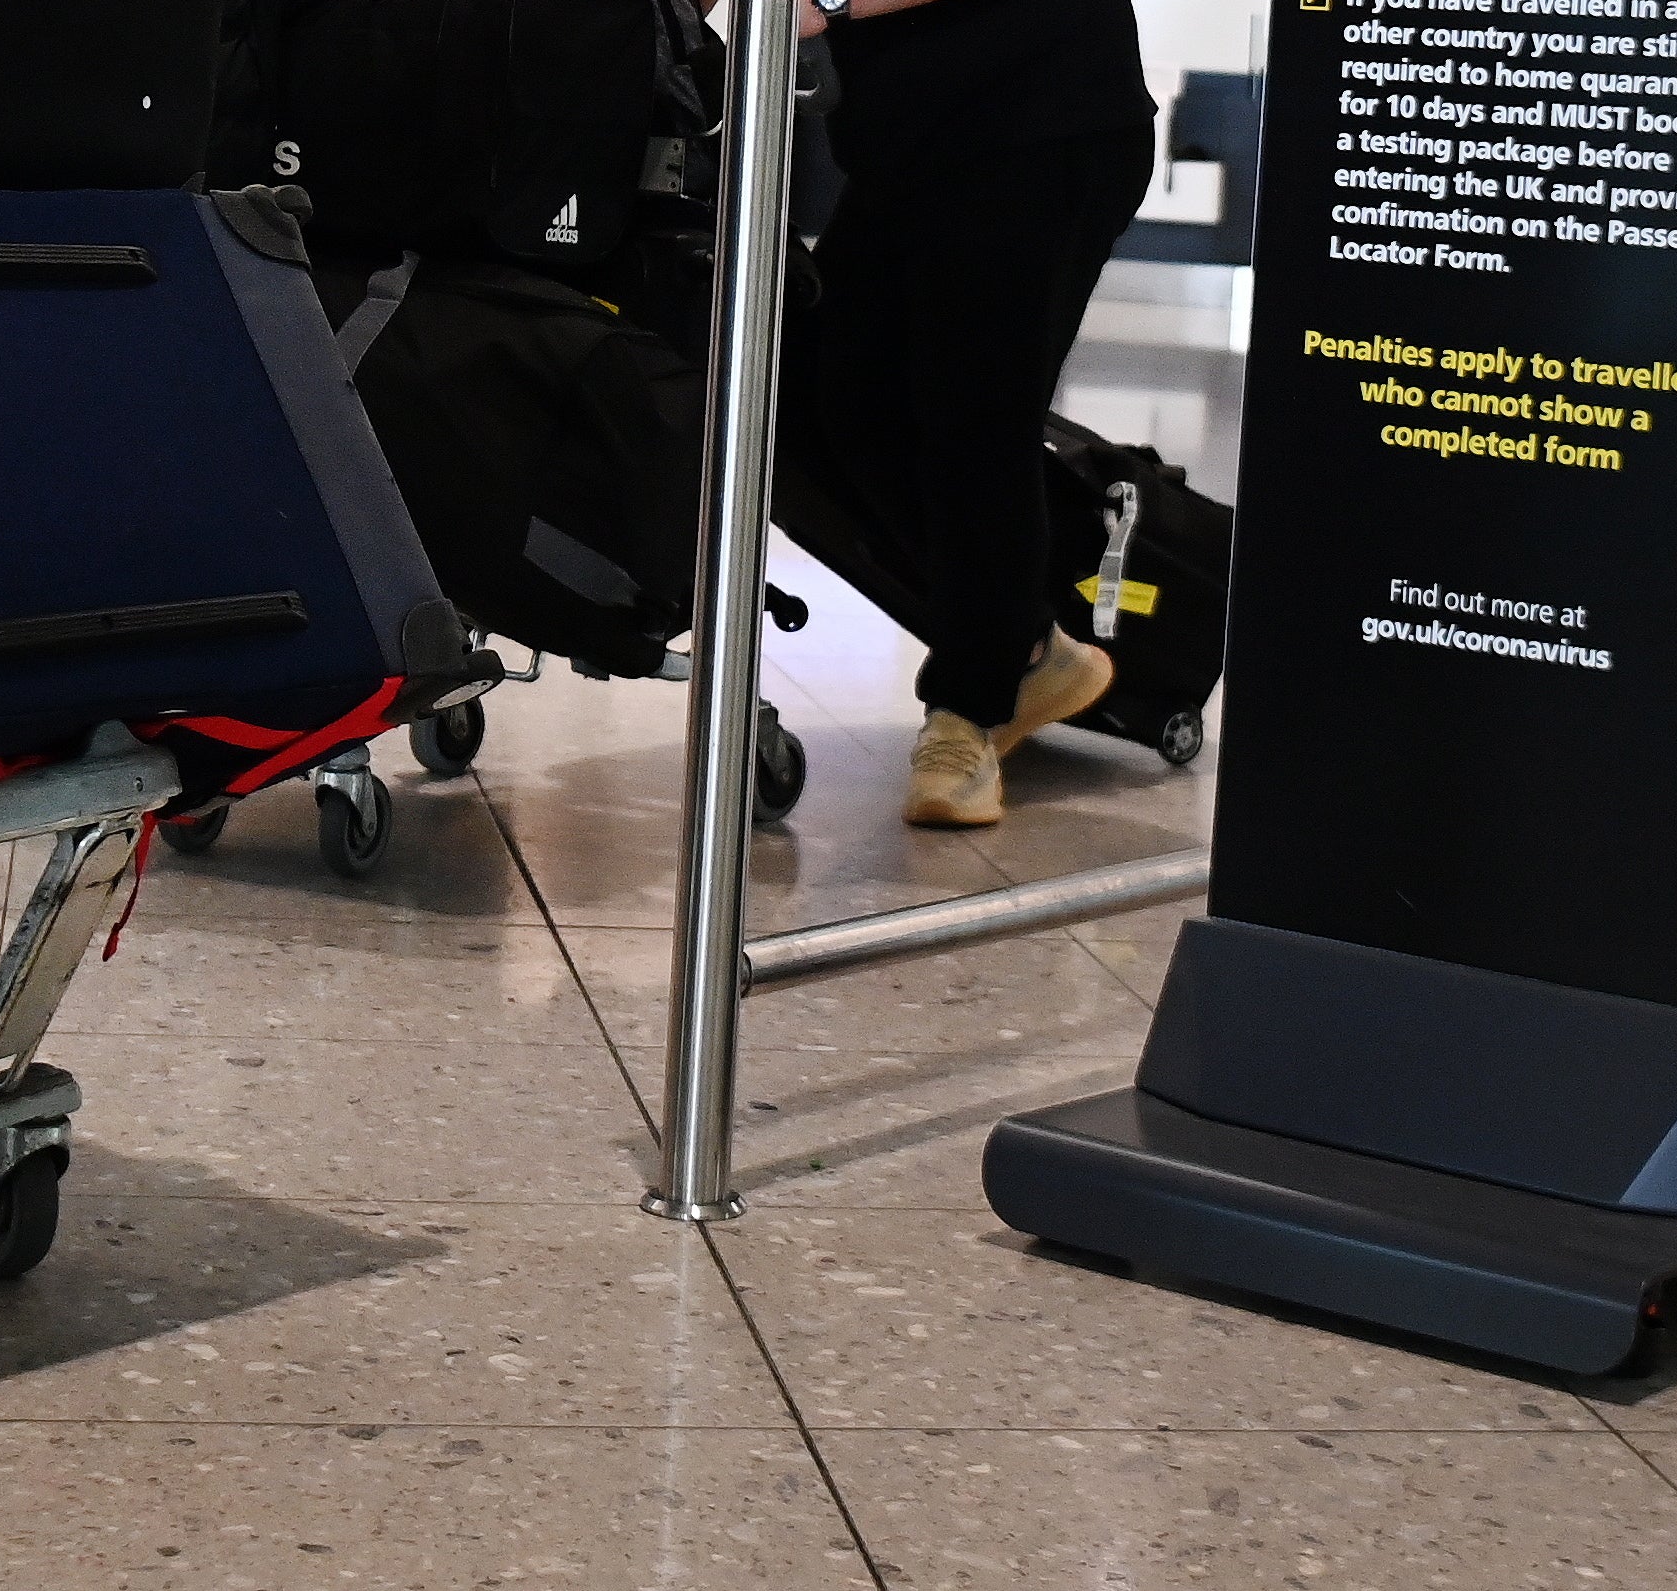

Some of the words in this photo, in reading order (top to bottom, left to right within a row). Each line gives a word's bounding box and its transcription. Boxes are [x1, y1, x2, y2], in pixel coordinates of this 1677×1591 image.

[1344, 20, 1415, 44] other
[1421, 26, 1525, 56] country
[1531, 33, 1584, 57] you
[1591, 36, 1636, 55] are
[1342, 58, 1454, 86] required
[1459, 62, 1488, 85] to
[1495, 62, 1574, 90] home
[1339, 90, 1379, 115] for
[1387, 94, 1417, 118] 10
[1423, 95, 1486, 127] days
[1491, 101, 1544, 125] and
[1551, 103, 1630, 130] MUST
[1337, 133, 1353, 150] a
[1359, 130, 1452, 163] testing
[1458, 137, 1572, 170] package
[1578, 141, 1672, 171] before
[1335, 167, 1447, 199] entering
[1453, 171, 1499, 197] the
[1506, 175, 1543, 200] UK
[1551, 180, 1605, 204] and
[545, 224, 579, 245] adidas
[1332, 202, 1505, 234] confirmation
[1512, 218, 1548, 238] on
[1554, 215, 1602, 242] the
[1330, 236, 1428, 265] Locator
[1434, 244, 1509, 272] Form.
[1304, 330, 1433, 366] Penalties
[1441, 347, 1524, 382] apply
[1530, 353, 1564, 379] to
[1360, 377, 1424, 406] who
[1431, 390, 1532, 418] cannot
[1539, 395, 1623, 427] show
[1631, 410, 1650, 431] a
[1381, 425, 1536, 460] completed
[1544, 436, 1620, 470] form
[1391, 579, 1437, 607] Find
[1445, 593, 1485, 614] out
[1491, 599, 1554, 623] more
[1561, 606, 1585, 628] at
[1362, 614, 1611, 669] gov.uk/coronavirus
